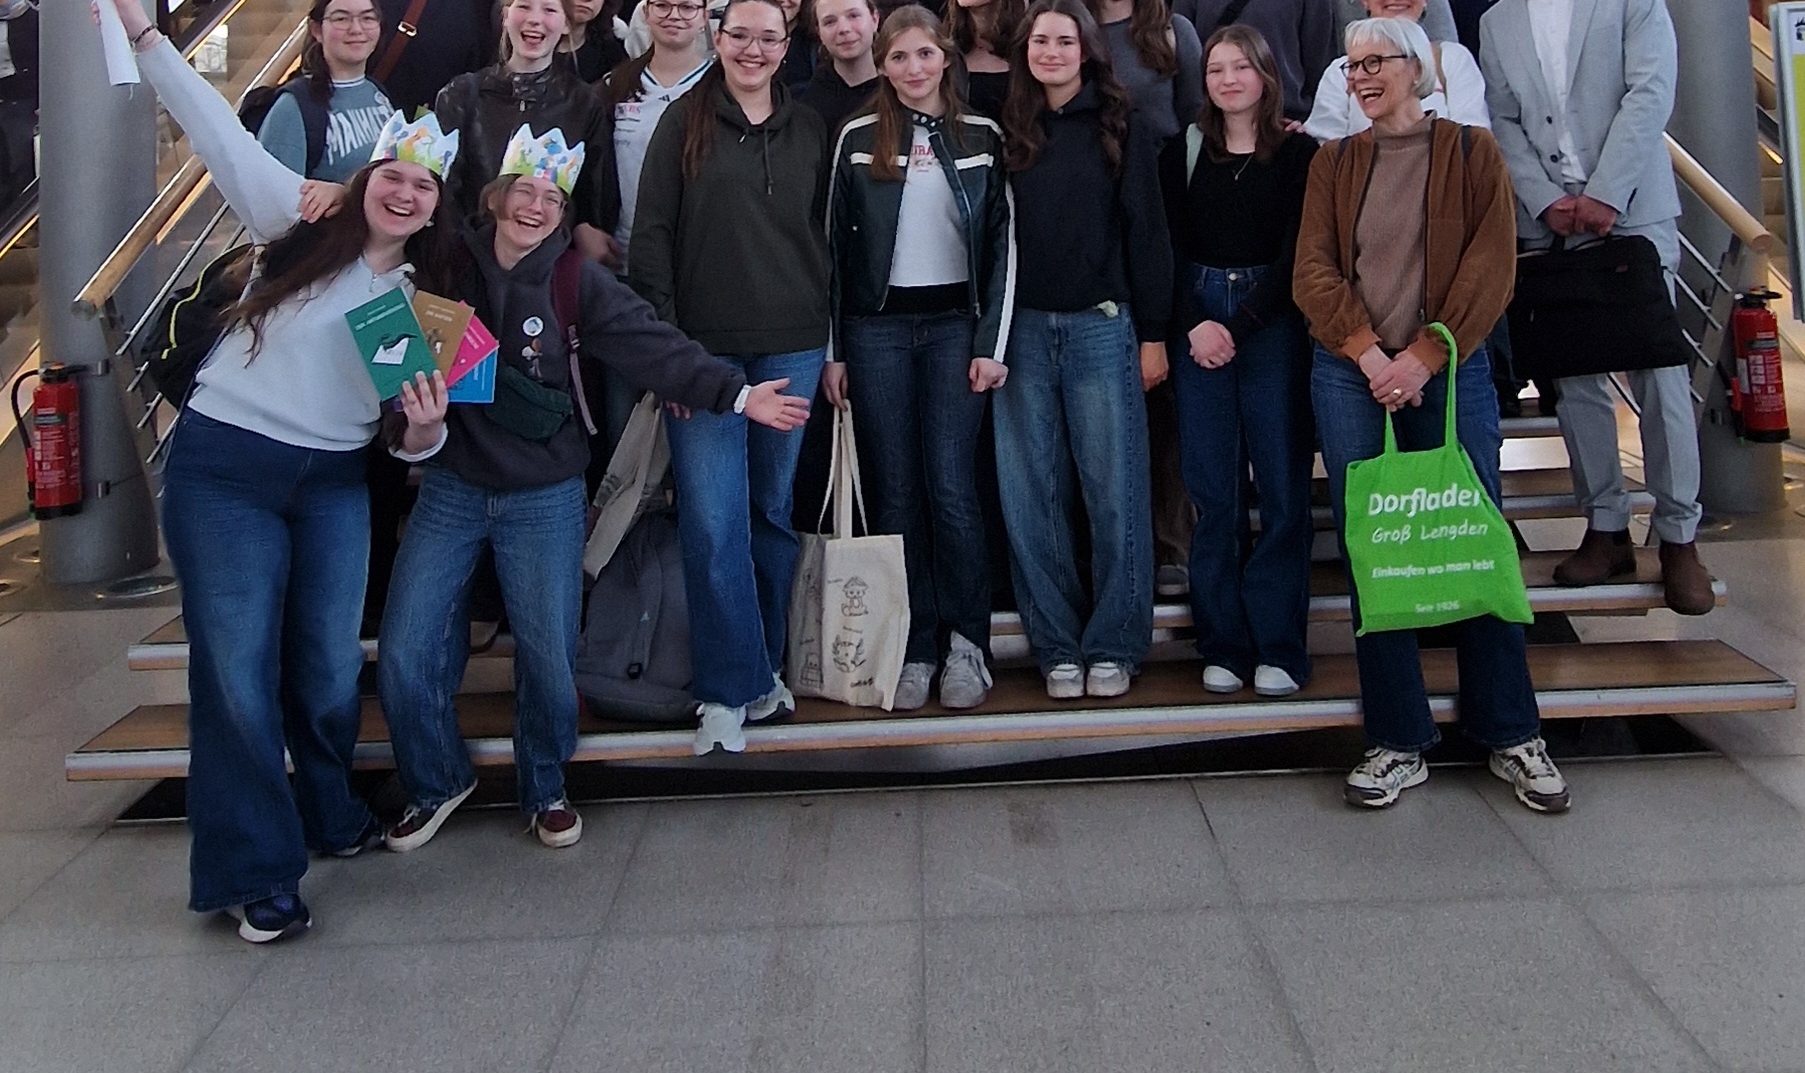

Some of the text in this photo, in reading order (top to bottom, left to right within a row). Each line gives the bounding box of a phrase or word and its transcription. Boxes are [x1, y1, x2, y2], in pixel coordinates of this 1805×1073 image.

[1372, 519, 1488, 544] Groß Lengden
[1372, 559, 1496, 578] Einkaufen wo man lebt
